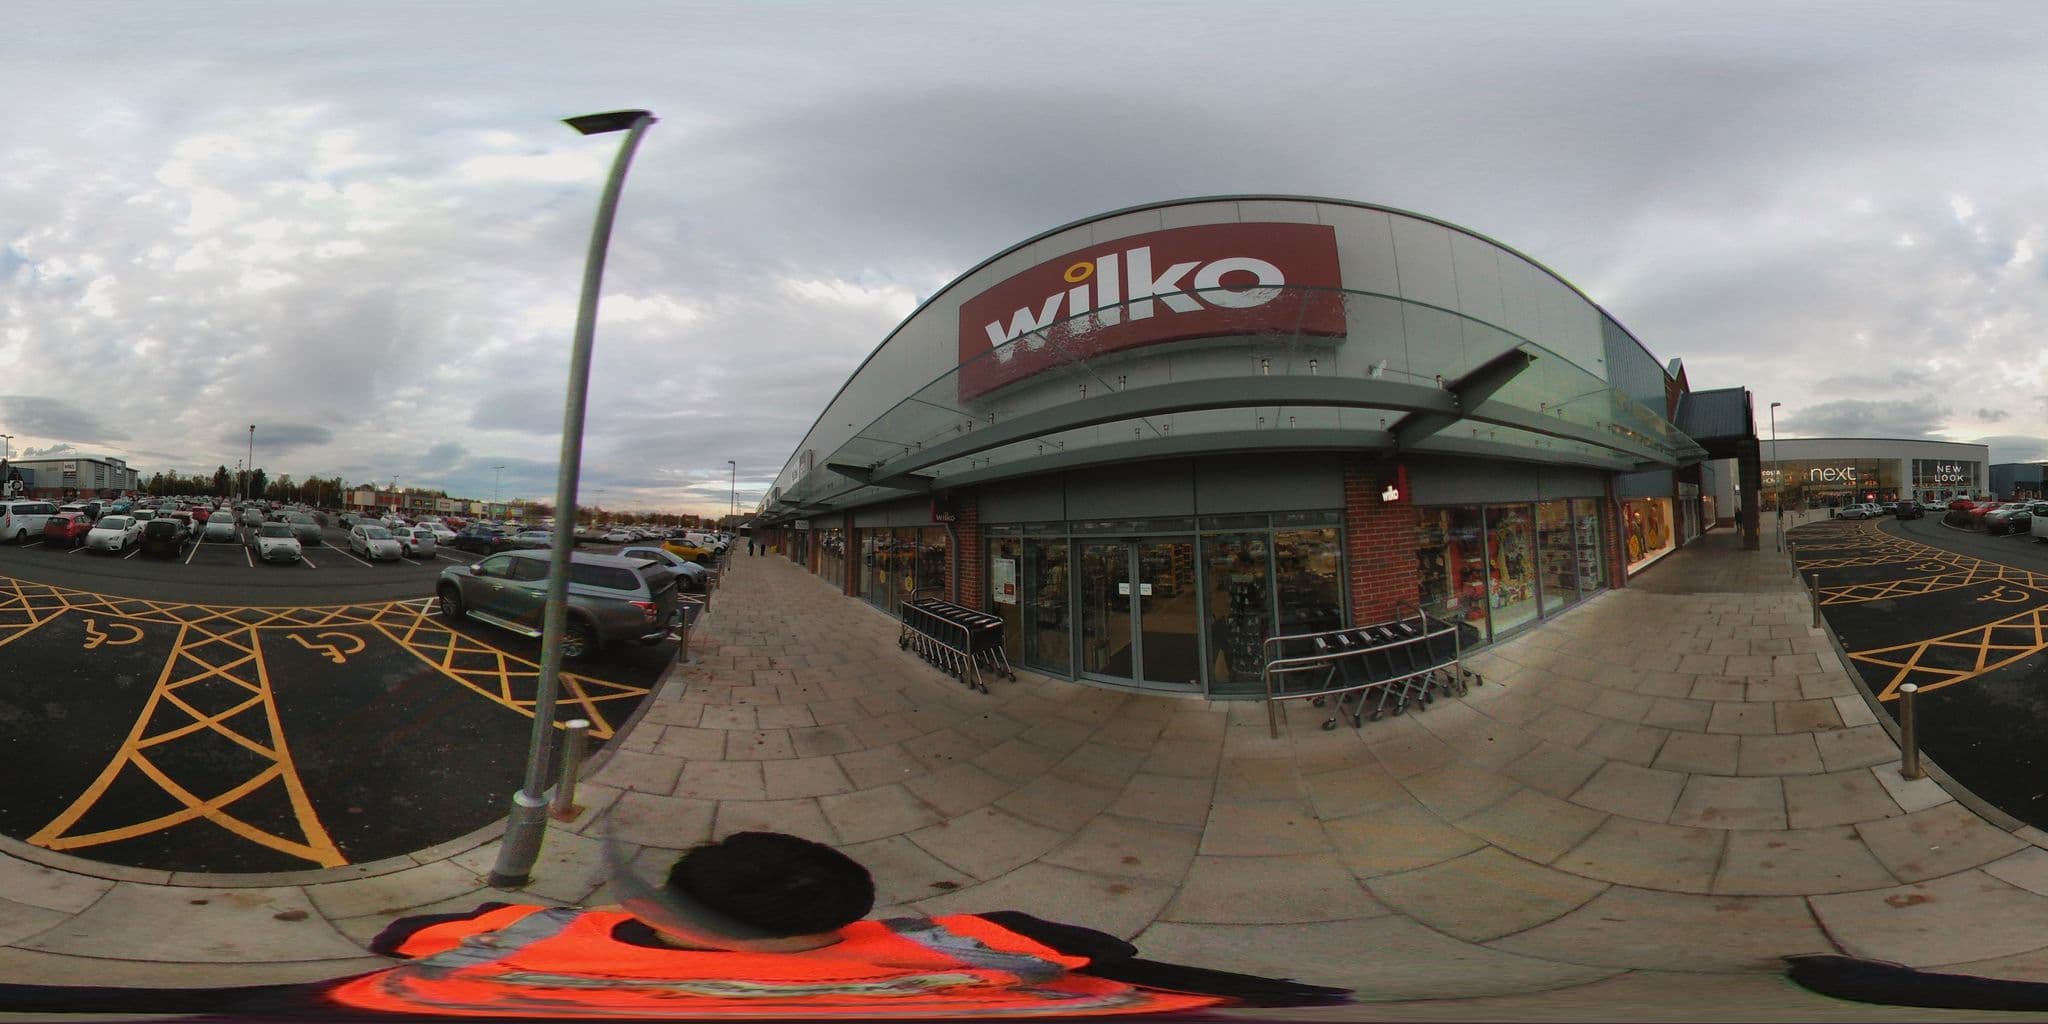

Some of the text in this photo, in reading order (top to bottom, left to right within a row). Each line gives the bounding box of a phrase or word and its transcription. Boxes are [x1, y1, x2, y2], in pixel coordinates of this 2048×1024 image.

[985, 246, 1285, 364] wilko
[1810, 466, 1857, 481] next
[1936, 465, 1961, 473] NEW
[1934, 474, 1964, 482] LOOK
